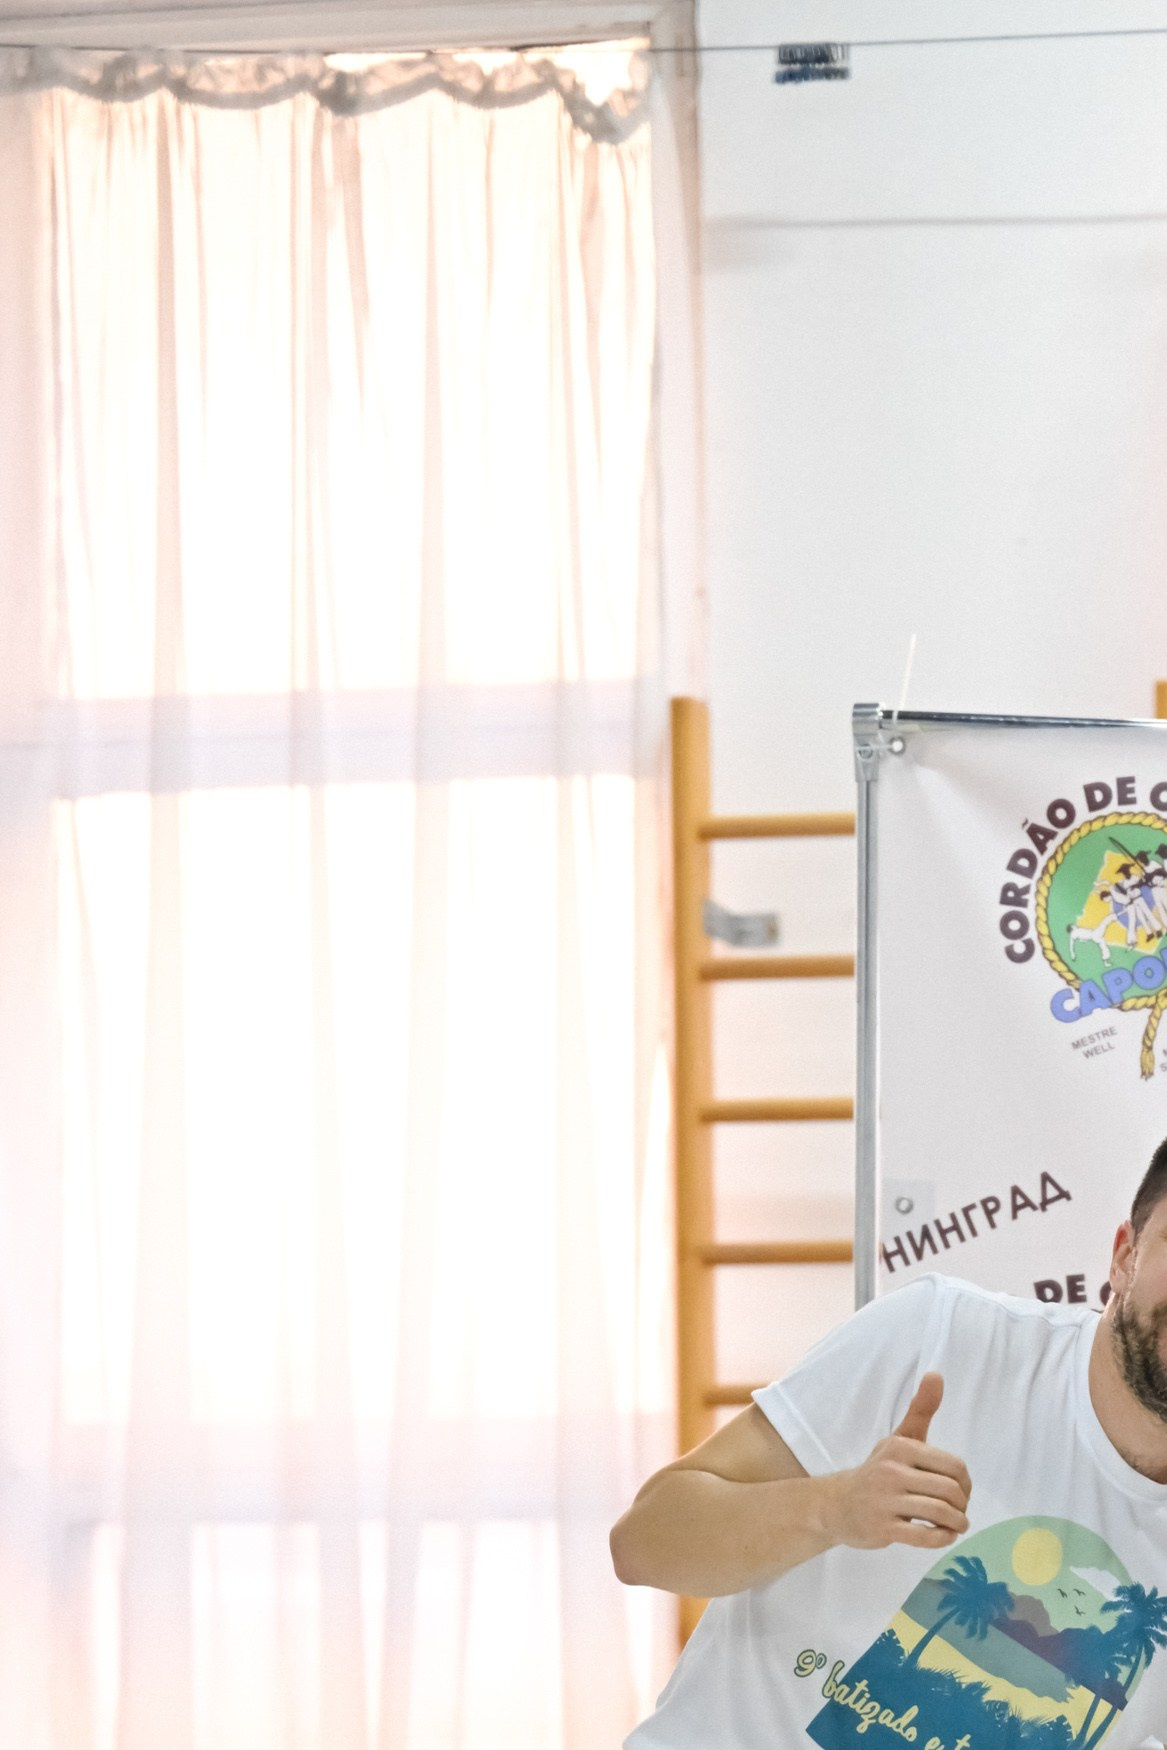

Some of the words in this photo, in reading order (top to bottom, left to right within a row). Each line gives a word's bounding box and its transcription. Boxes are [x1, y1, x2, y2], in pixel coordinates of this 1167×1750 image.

[999, 798, 1076, 964] CORDÃO
[1083, 776, 1137, 812] DE
[1071, 1026, 1118, 1050] MESTRE
[1083, 1041, 1116, 1060] WELL
[822, 1660, 920, 1742] batizado
